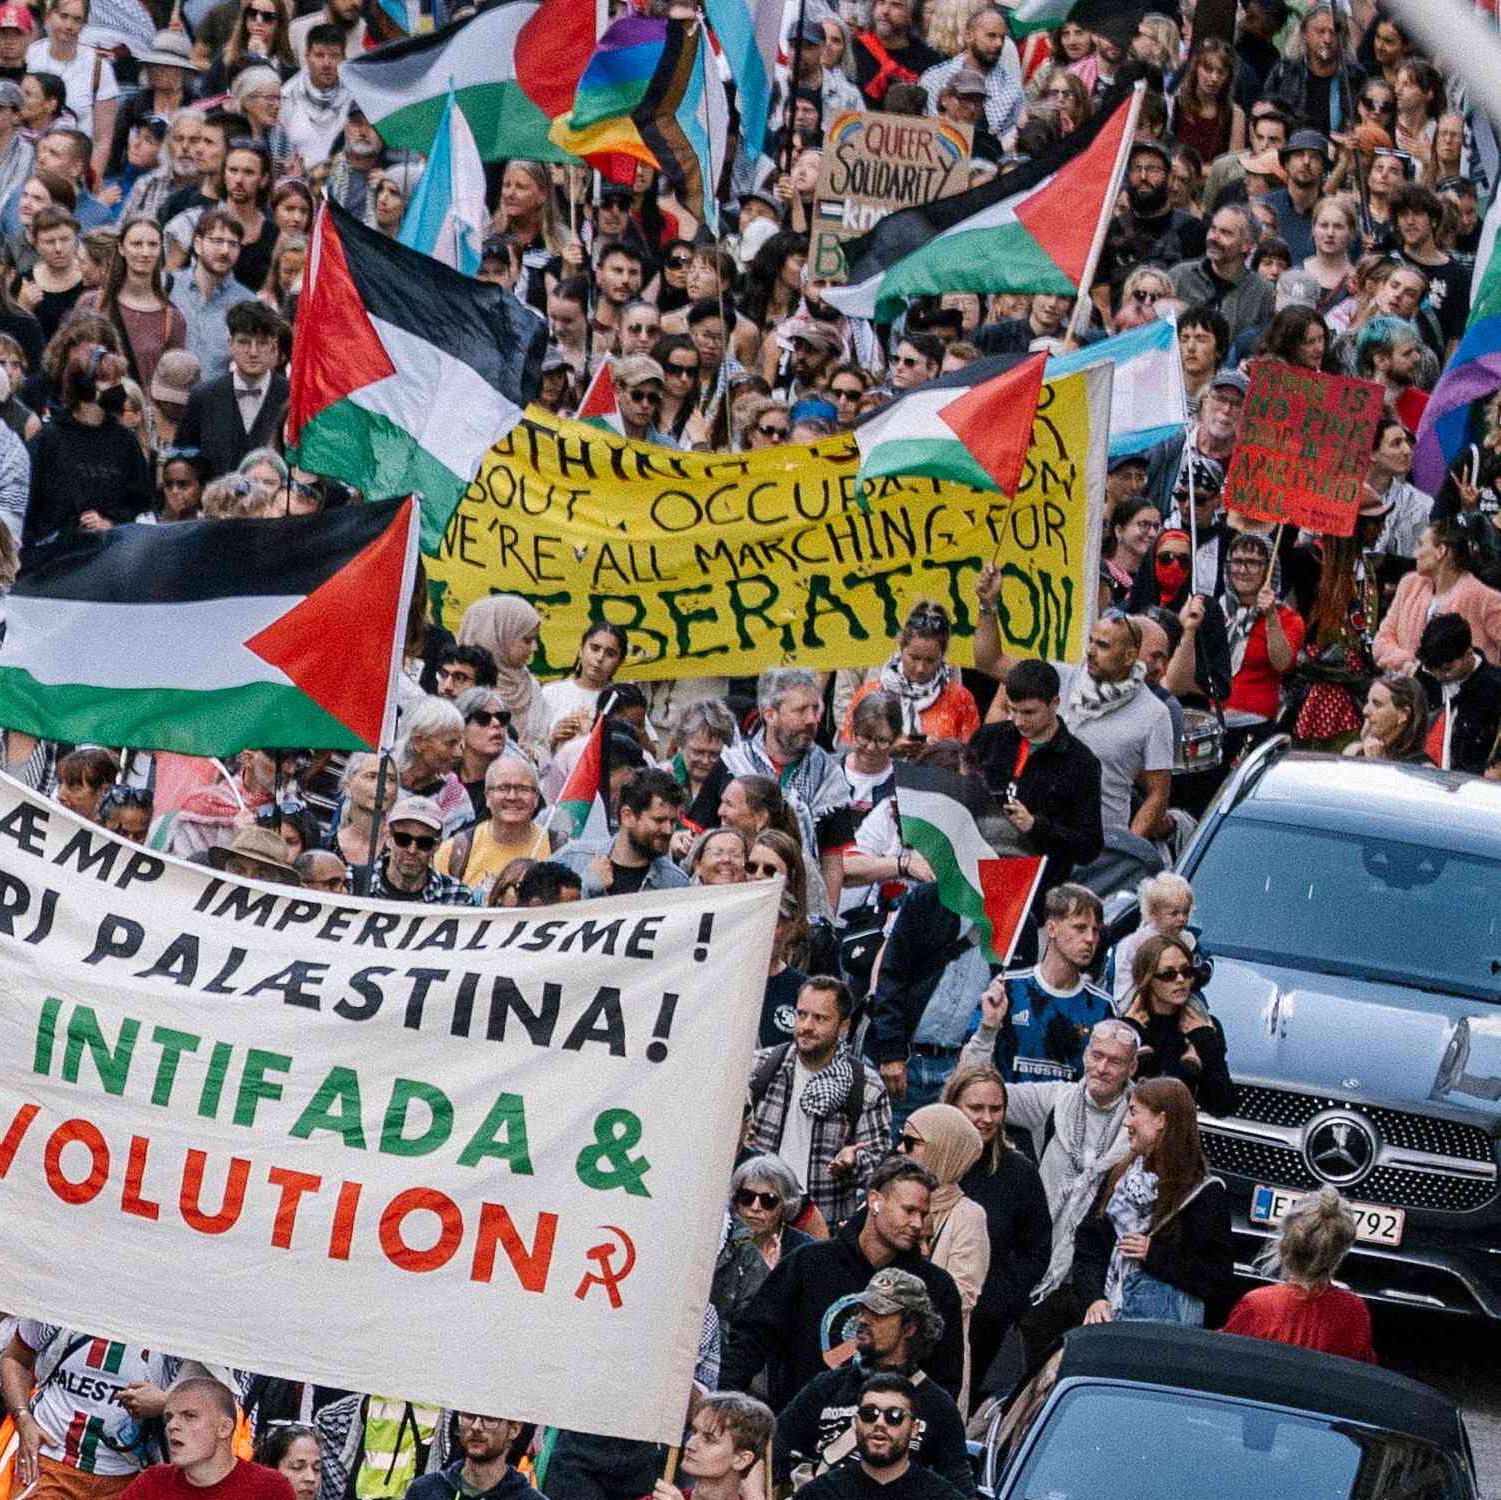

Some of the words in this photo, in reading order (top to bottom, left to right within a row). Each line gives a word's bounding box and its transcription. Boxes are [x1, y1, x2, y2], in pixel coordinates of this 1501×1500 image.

[865, 123, 933, 163] QUEER
[593, 541, 677, 584] ALL
[193, 876, 667, 961] IMPERIALISME
[32, 996, 535, 1176] INTIFADA
[575, 1107, 653, 1199] &
